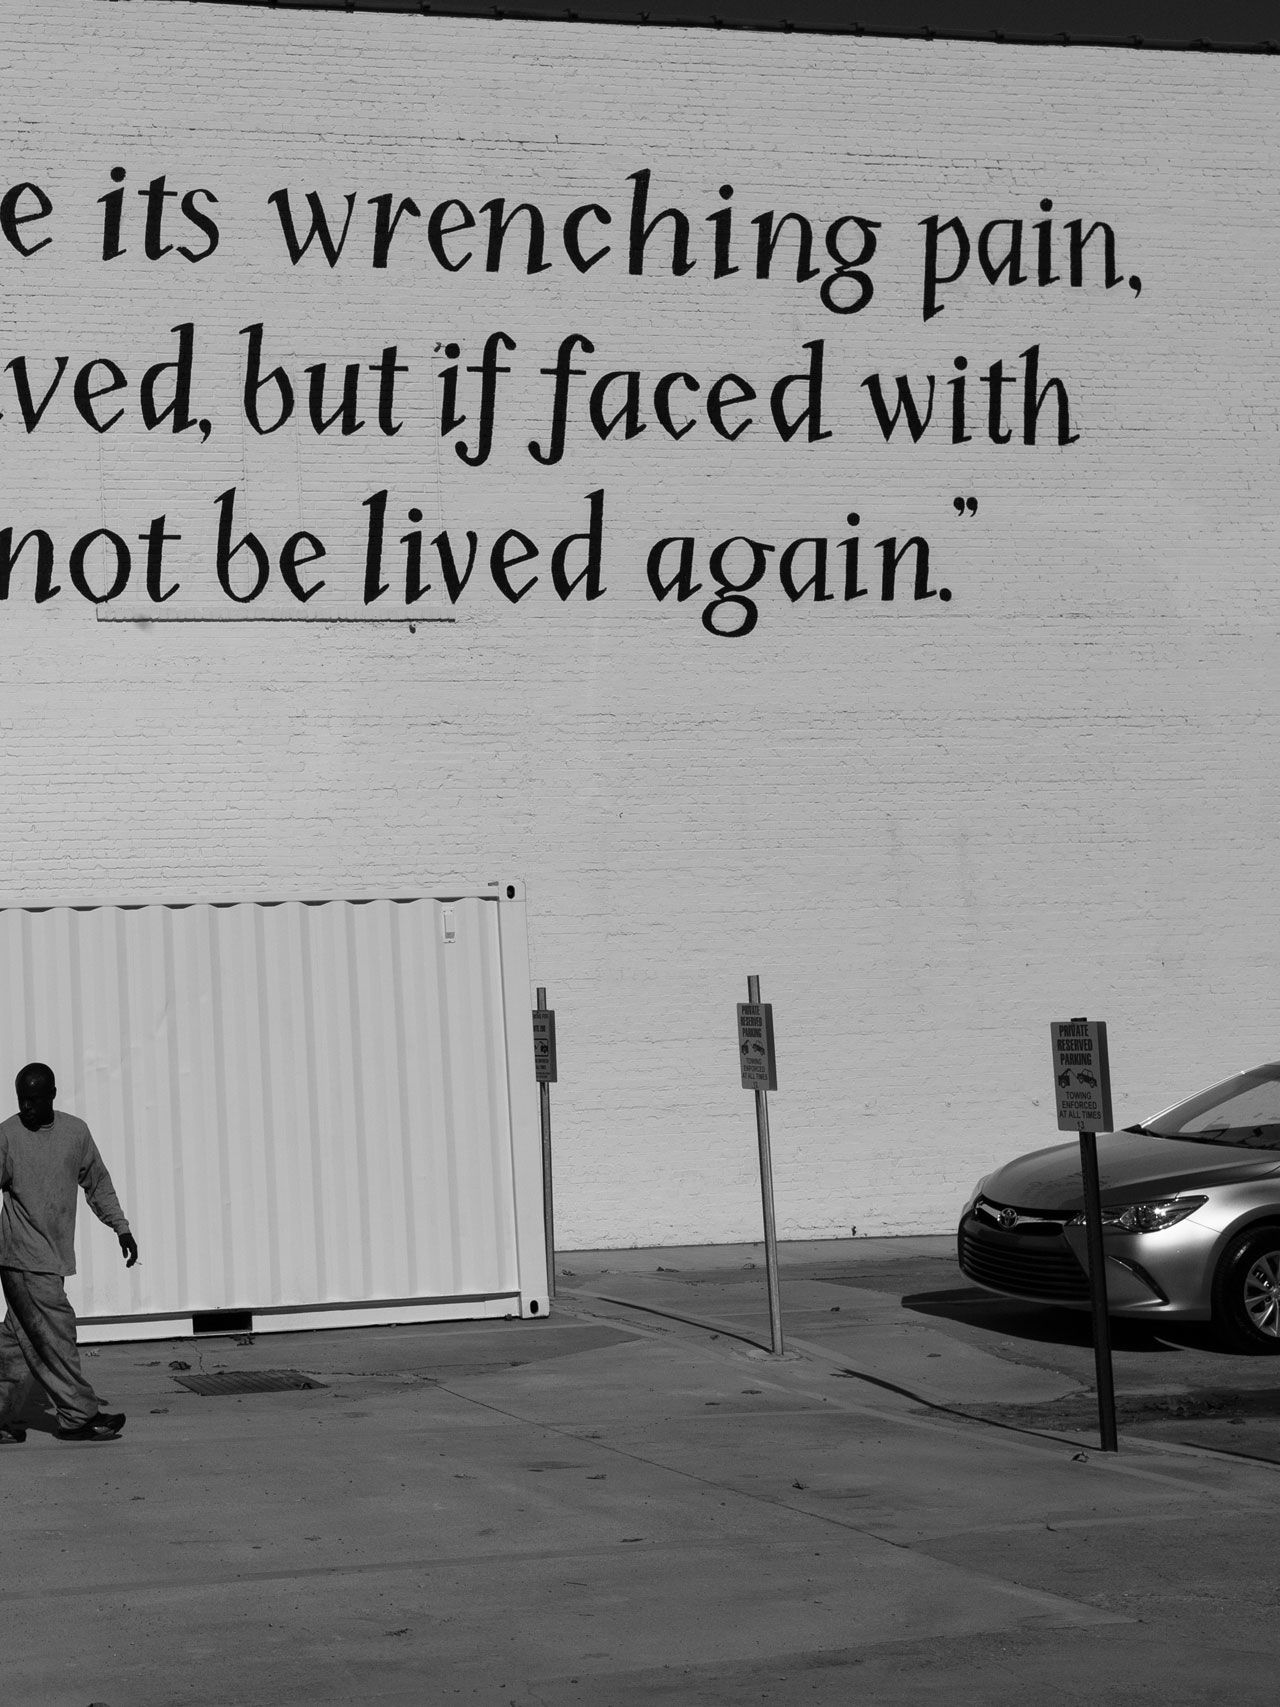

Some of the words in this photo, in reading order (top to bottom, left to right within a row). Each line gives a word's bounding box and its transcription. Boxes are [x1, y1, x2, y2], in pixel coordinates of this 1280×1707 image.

[96, 166, 220, 264] its
[267, 167, 882, 315] wrenching
[917, 197, 1142, 323] pain,
[238, 322, 410, 437] but
[437, 331, 517, 467] if
[527, 333, 833, 466] faced
[860, 342, 1081, 447] with
[213, 486, 327, 606] be
[361, 489, 608, 606] lived
[646, 496, 979, 638] again.”
[1059, 1024, 1089, 1037] PRIVATE
[1057, 1038, 1093, 1052] RESERVED
[1060, 1052, 1092, 1066] PARKING
[1065, 1091, 1092, 1100] TOWING
[1061, 1100, 1097, 1110] ENFORCED
[1059, 1110, 1068, 1118] AT
[1069, 1111, 1080, 1119] ALL
[1082, 1111, 1102, 1120] TIMES
[1076, 1120, 1085, 1130] 13
